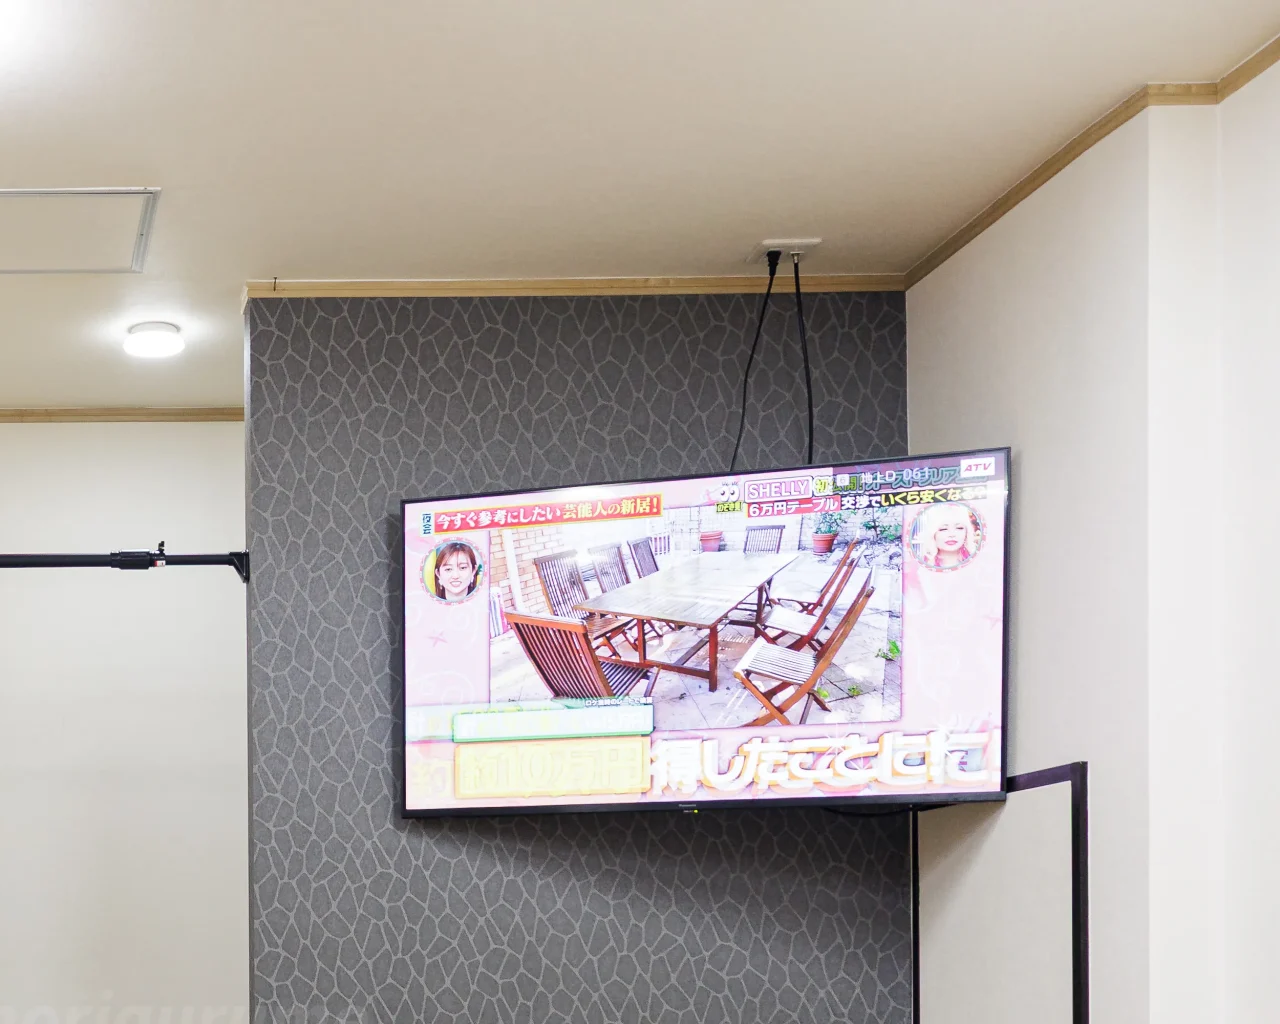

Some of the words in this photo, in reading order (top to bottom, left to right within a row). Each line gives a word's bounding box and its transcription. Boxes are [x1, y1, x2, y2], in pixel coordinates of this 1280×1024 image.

[963, 462, 992, 473] ATV
[747, 478, 809, 500] SHELLY
[748, 497, 838, 517] 6万円テーブル
